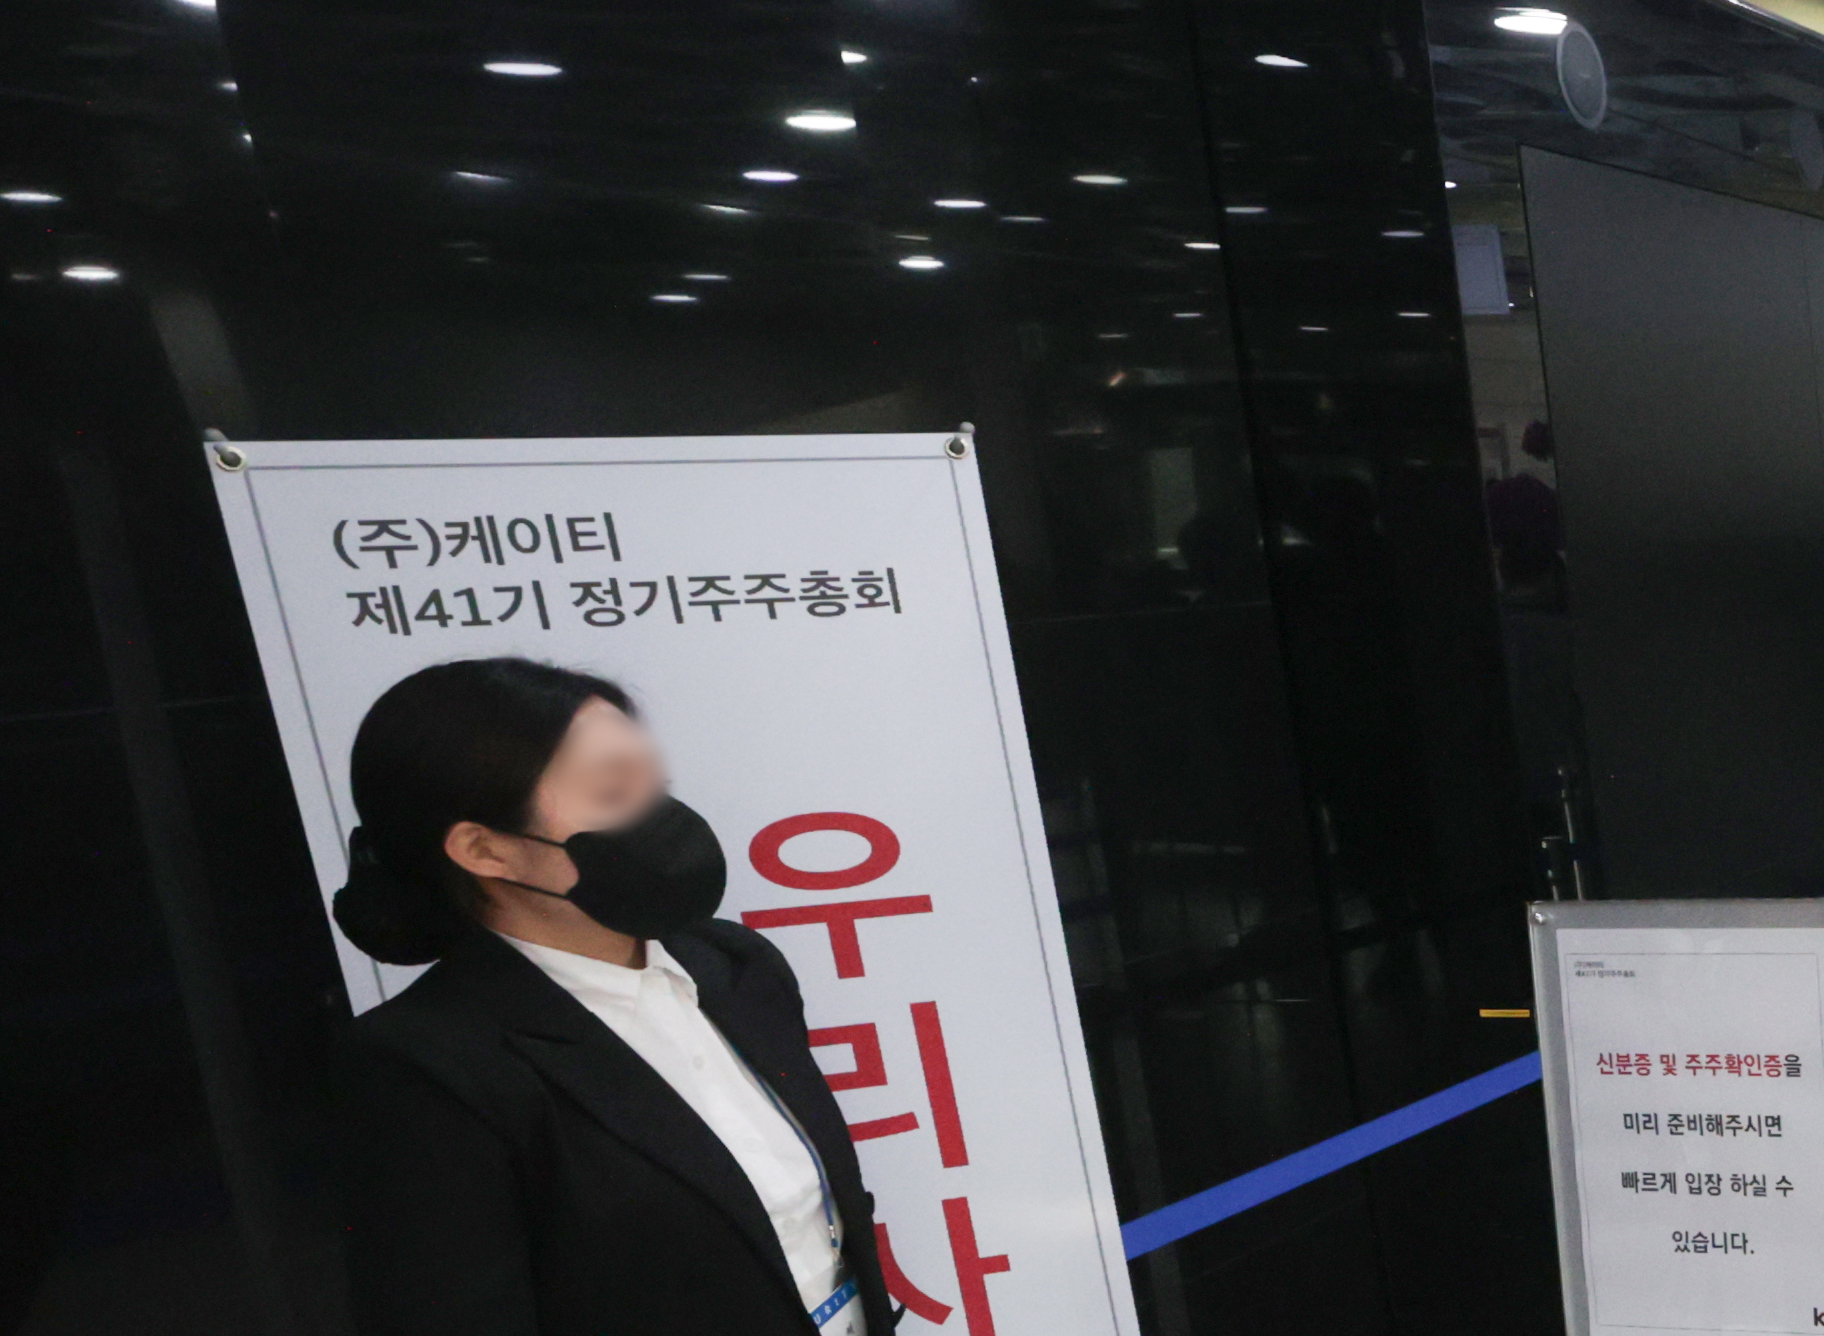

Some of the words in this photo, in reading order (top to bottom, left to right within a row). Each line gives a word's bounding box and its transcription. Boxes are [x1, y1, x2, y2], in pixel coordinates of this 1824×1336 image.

[331, 510, 623, 570] (주)케이티
[348, 584, 553, 638] 제41기
[566, 565, 904, 629] 정기주주총회
[1596, 1052, 1653, 1077] 신분증
[1659, 1053, 1678, 1077] 및
[1684, 1053, 1803, 1078] 주주확인증을
[1622, 1112, 1660, 1136] 미리
[1666, 1113, 1783, 1138] 준비해주시면
[1620, 1170, 1678, 1195] 빠르게
[1684, 1172, 1723, 1197] 입장
[1729, 1173, 1768, 1198] 하실
[1774, 1174, 1795, 1198] 수
[1671, 1230, 1755, 1255] 있습니다.
